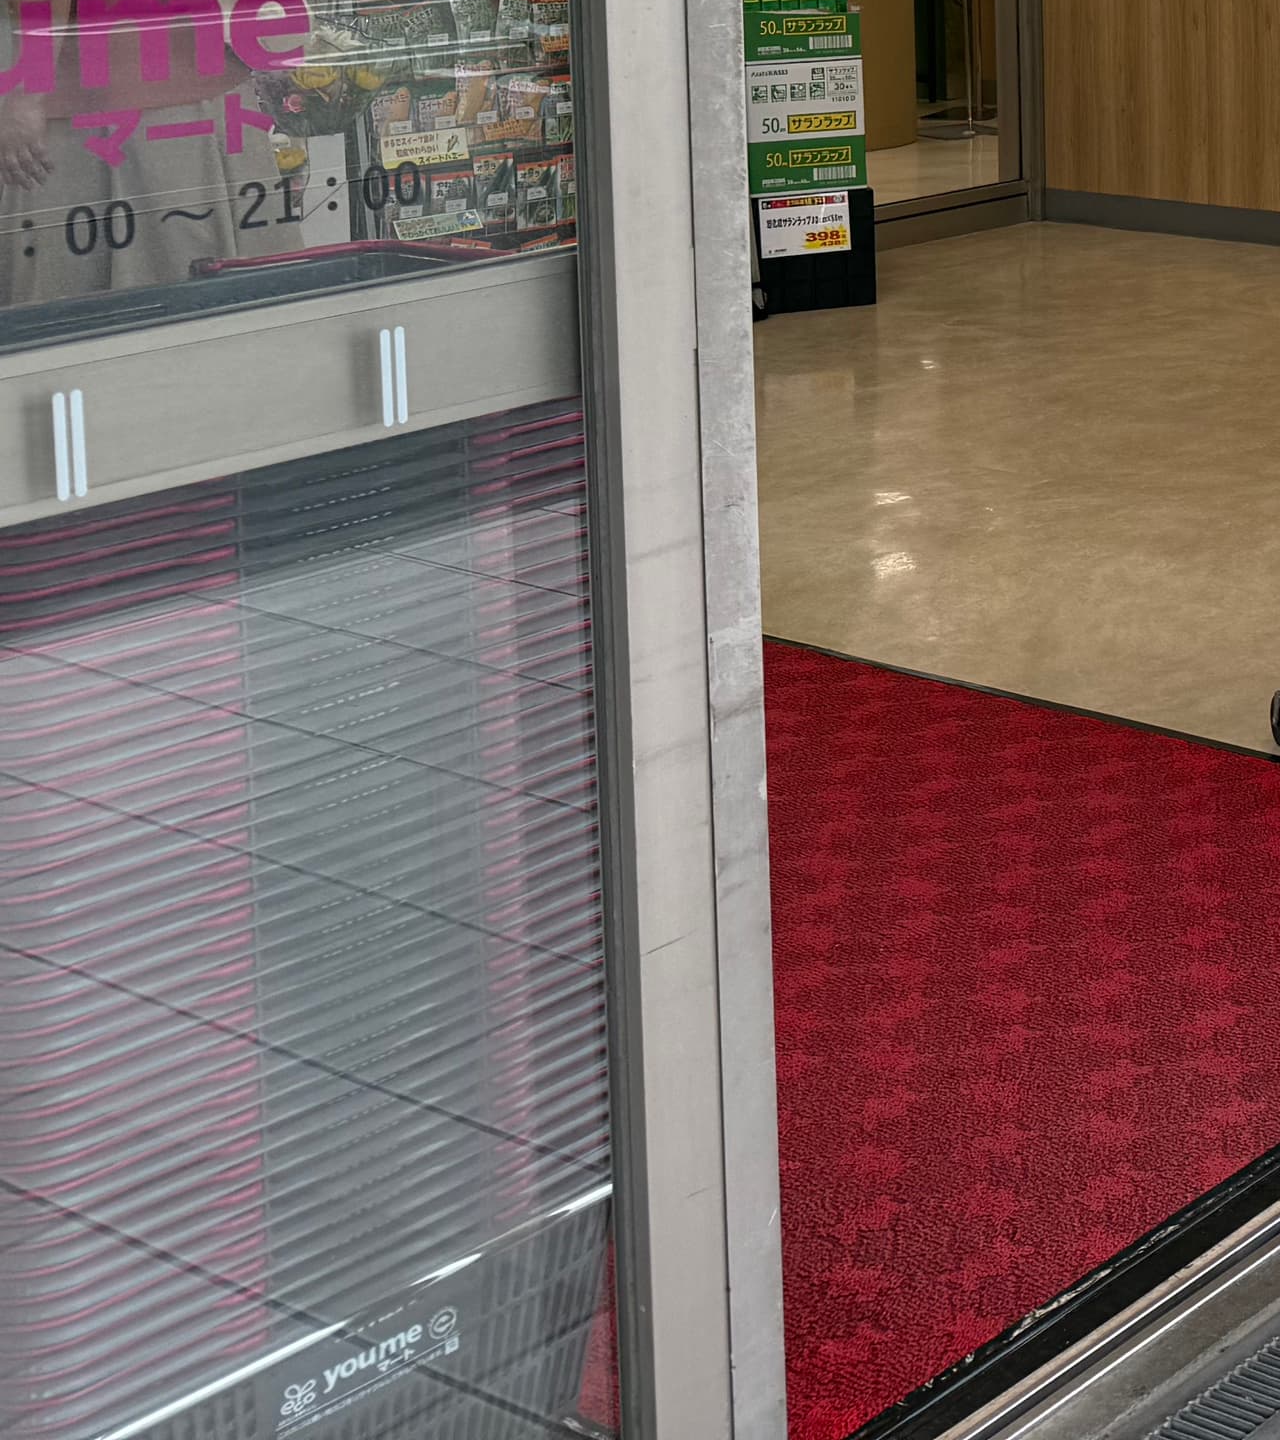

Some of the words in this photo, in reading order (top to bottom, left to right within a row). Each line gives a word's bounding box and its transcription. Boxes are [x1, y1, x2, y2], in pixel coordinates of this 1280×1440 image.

[786, 19, 843, 33] サランラップ
[791, 113, 853, 130] サランラップ
[71, 93, 275, 169] マート
[793, 149, 848, 164] サランラップ
[805, 230, 840, 243] 398
[323, 1323, 423, 1395] youme
